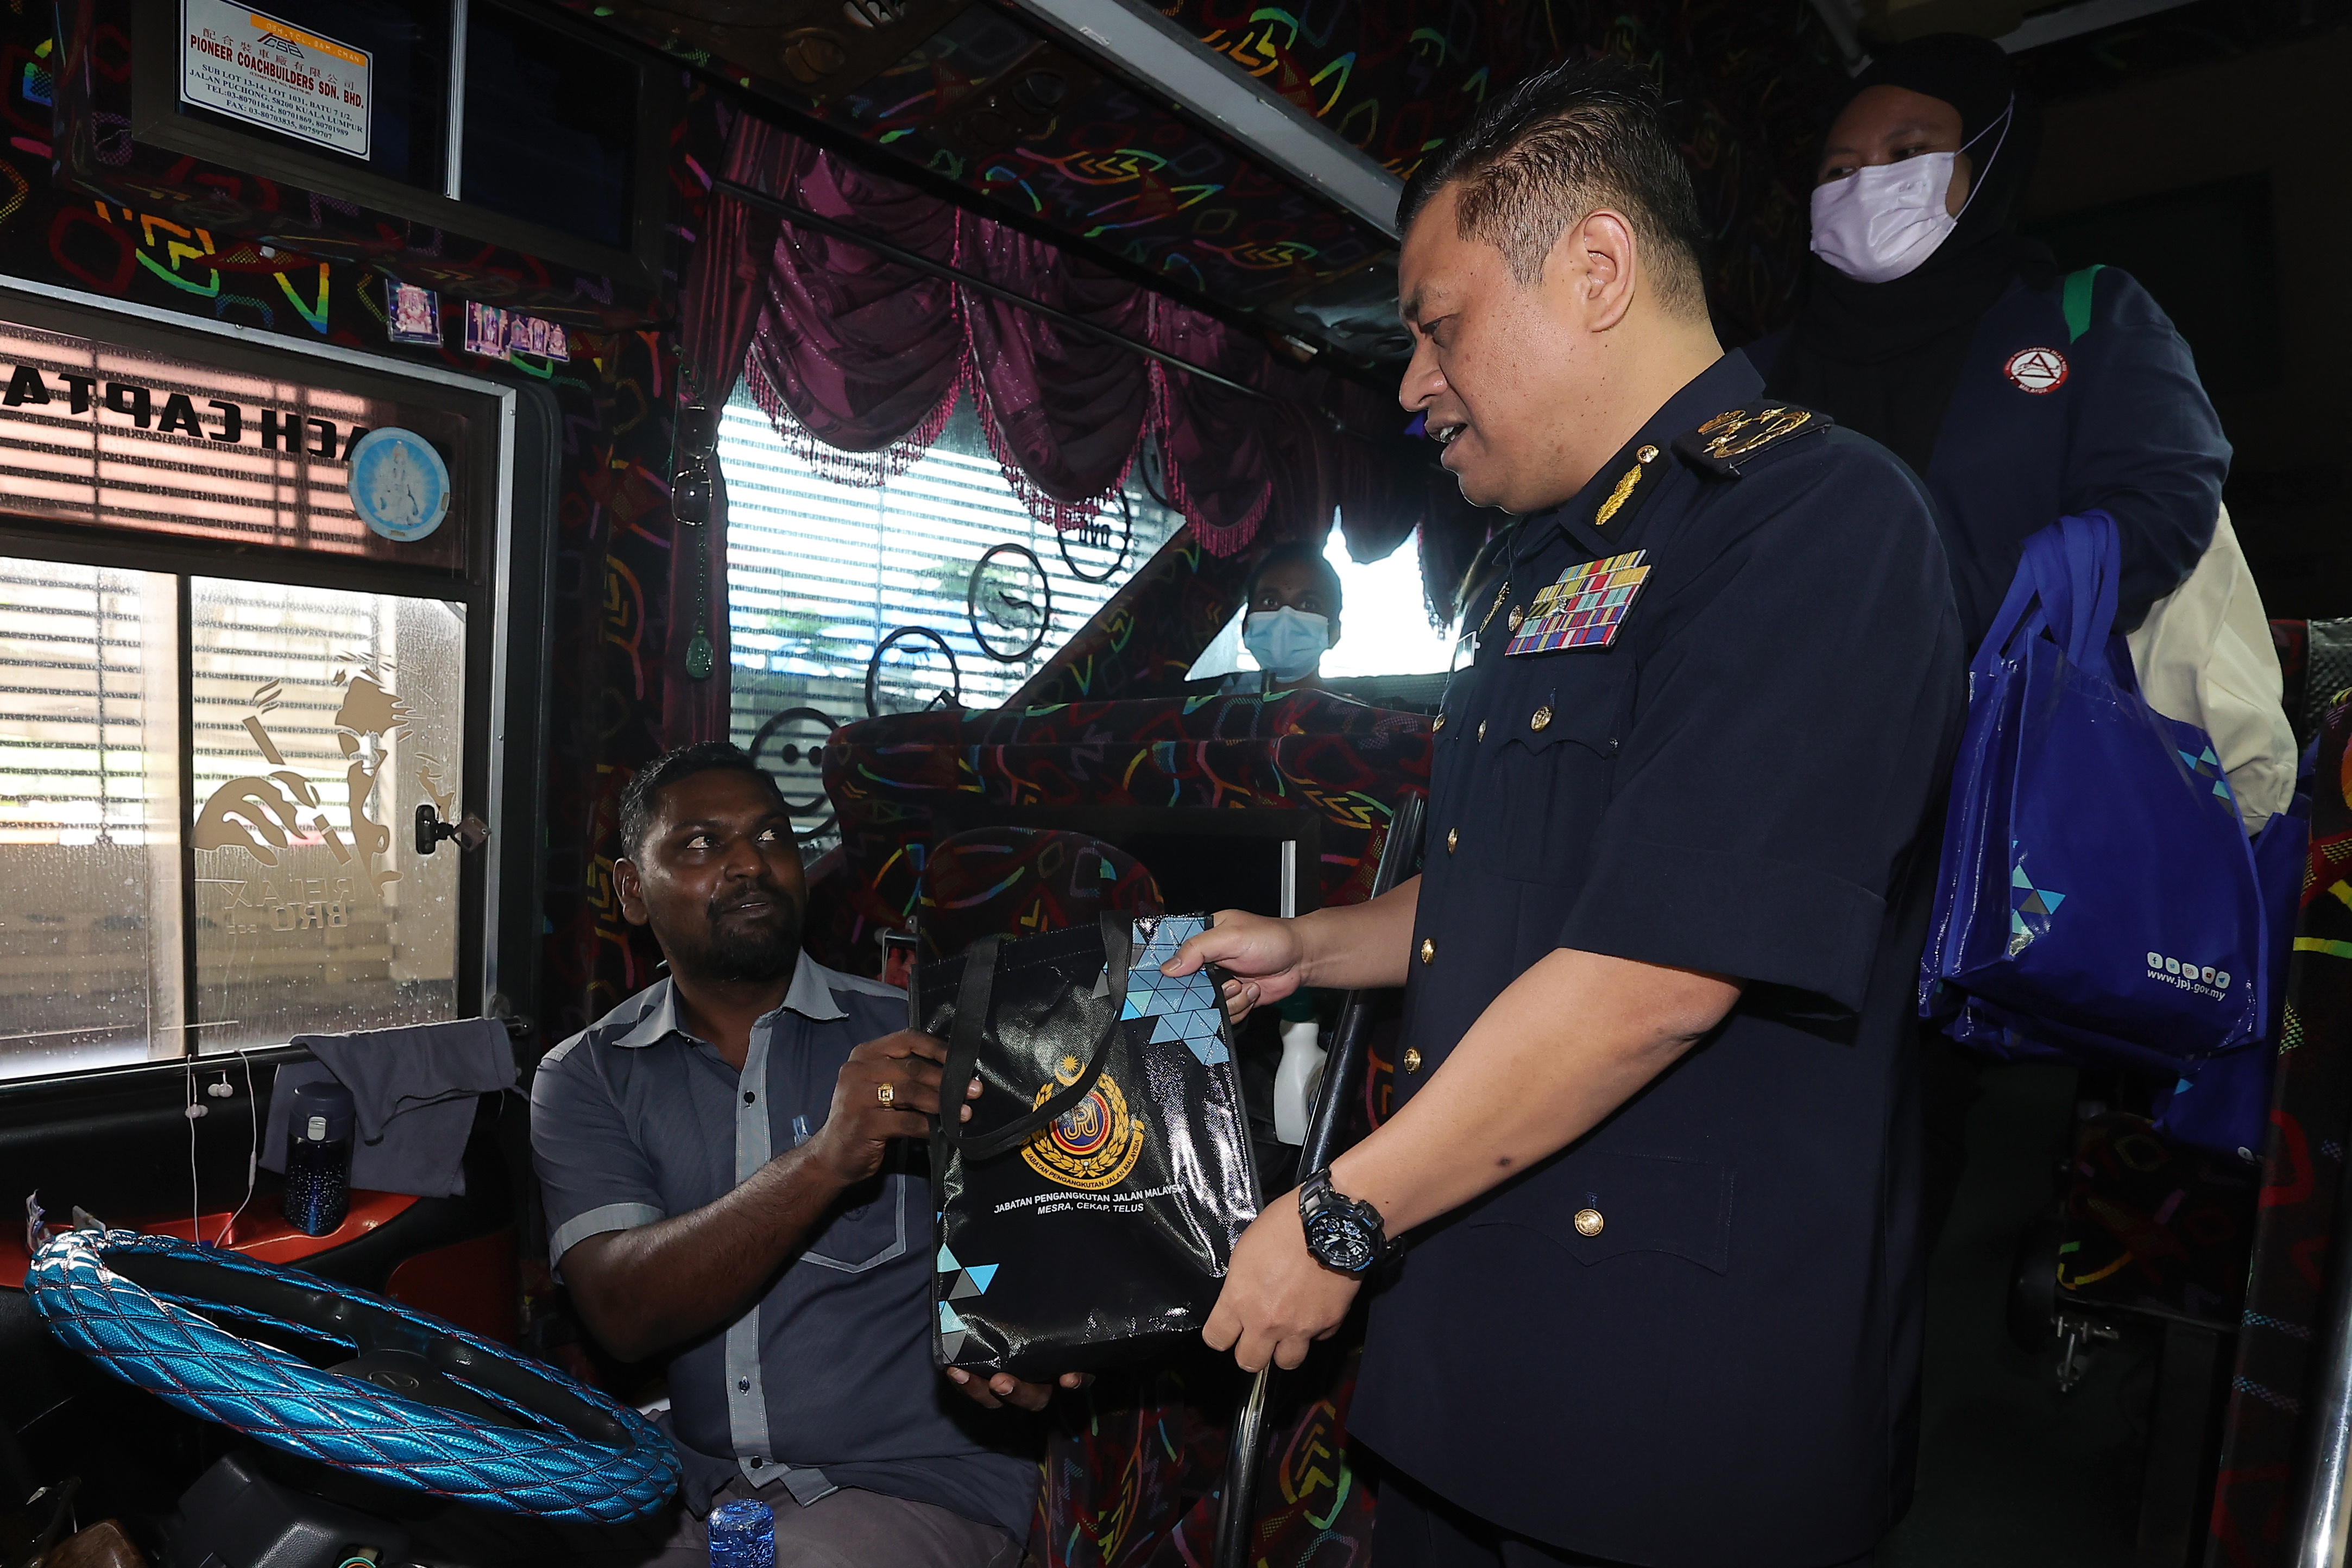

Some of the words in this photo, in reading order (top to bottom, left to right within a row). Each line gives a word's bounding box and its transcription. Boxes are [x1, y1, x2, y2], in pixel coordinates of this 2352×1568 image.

[191, 34, 232, 62] PIONEER
[237, 52, 314, 91] COACHBUILDERS
[319, 81, 339, 100] SDN.
[344, 90, 364, 109] BHD.
[202, 64, 220, 75] SUB
[223, 71, 241, 82] LOT
[269, 87, 286, 98] LOT
[310, 101, 332, 113] BATU
[190, 69, 220, 84] JALAN
[272, 98, 293, 109] 58200
[296, 105, 325, 120] KUALA
[327, 116, 363, 132] LUMPUR
[226, 99, 247, 112] FAX:
[2147, 970, 2225, 1001] www.jpj.gov.my
[1026, 1153, 1049, 1174] JABATAN
[1049, 1171, 1104, 1188] PENGANGKUTAN
[1105, 1170, 1125, 1185] JALAN
[1124, 1140, 1140, 1172] MALAYSIA
[994, 1197, 1032, 1213] JABATAN
[1035, 1192, 1110, 1204] PENGANGKUTAN
[1113, 1190, 1143, 1202] JALAN
[1145, 1183, 1187, 1198] MALAYSIA
[1037, 1203, 1074, 1215] MESRA,
[1076, 1202, 1110, 1212] CEKAP,
[1113, 1203, 1144, 1212] TELUS
